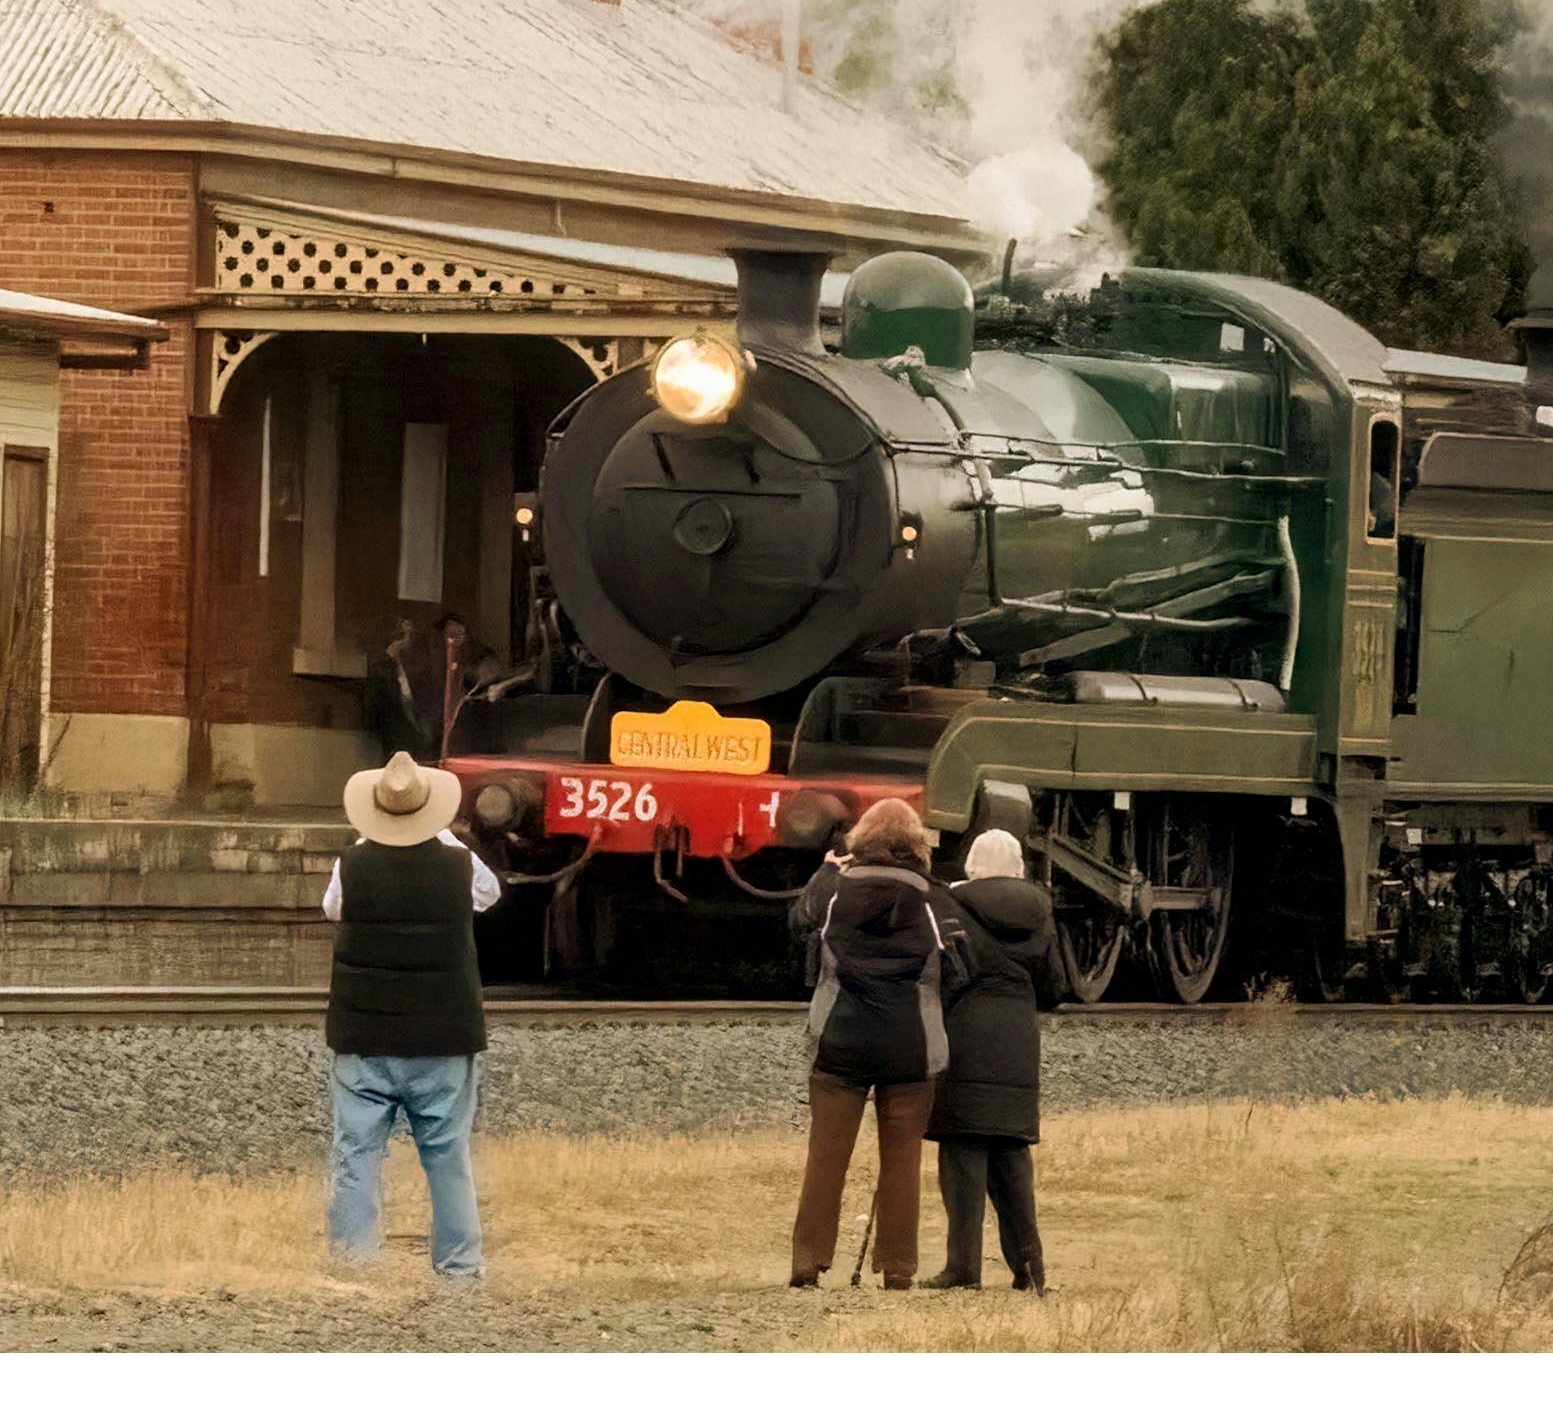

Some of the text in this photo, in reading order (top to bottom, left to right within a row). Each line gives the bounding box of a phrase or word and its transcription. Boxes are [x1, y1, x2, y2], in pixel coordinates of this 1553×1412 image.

[617, 730, 764, 763] CENTRAL WEST
[559, 776, 657, 822] 3526
